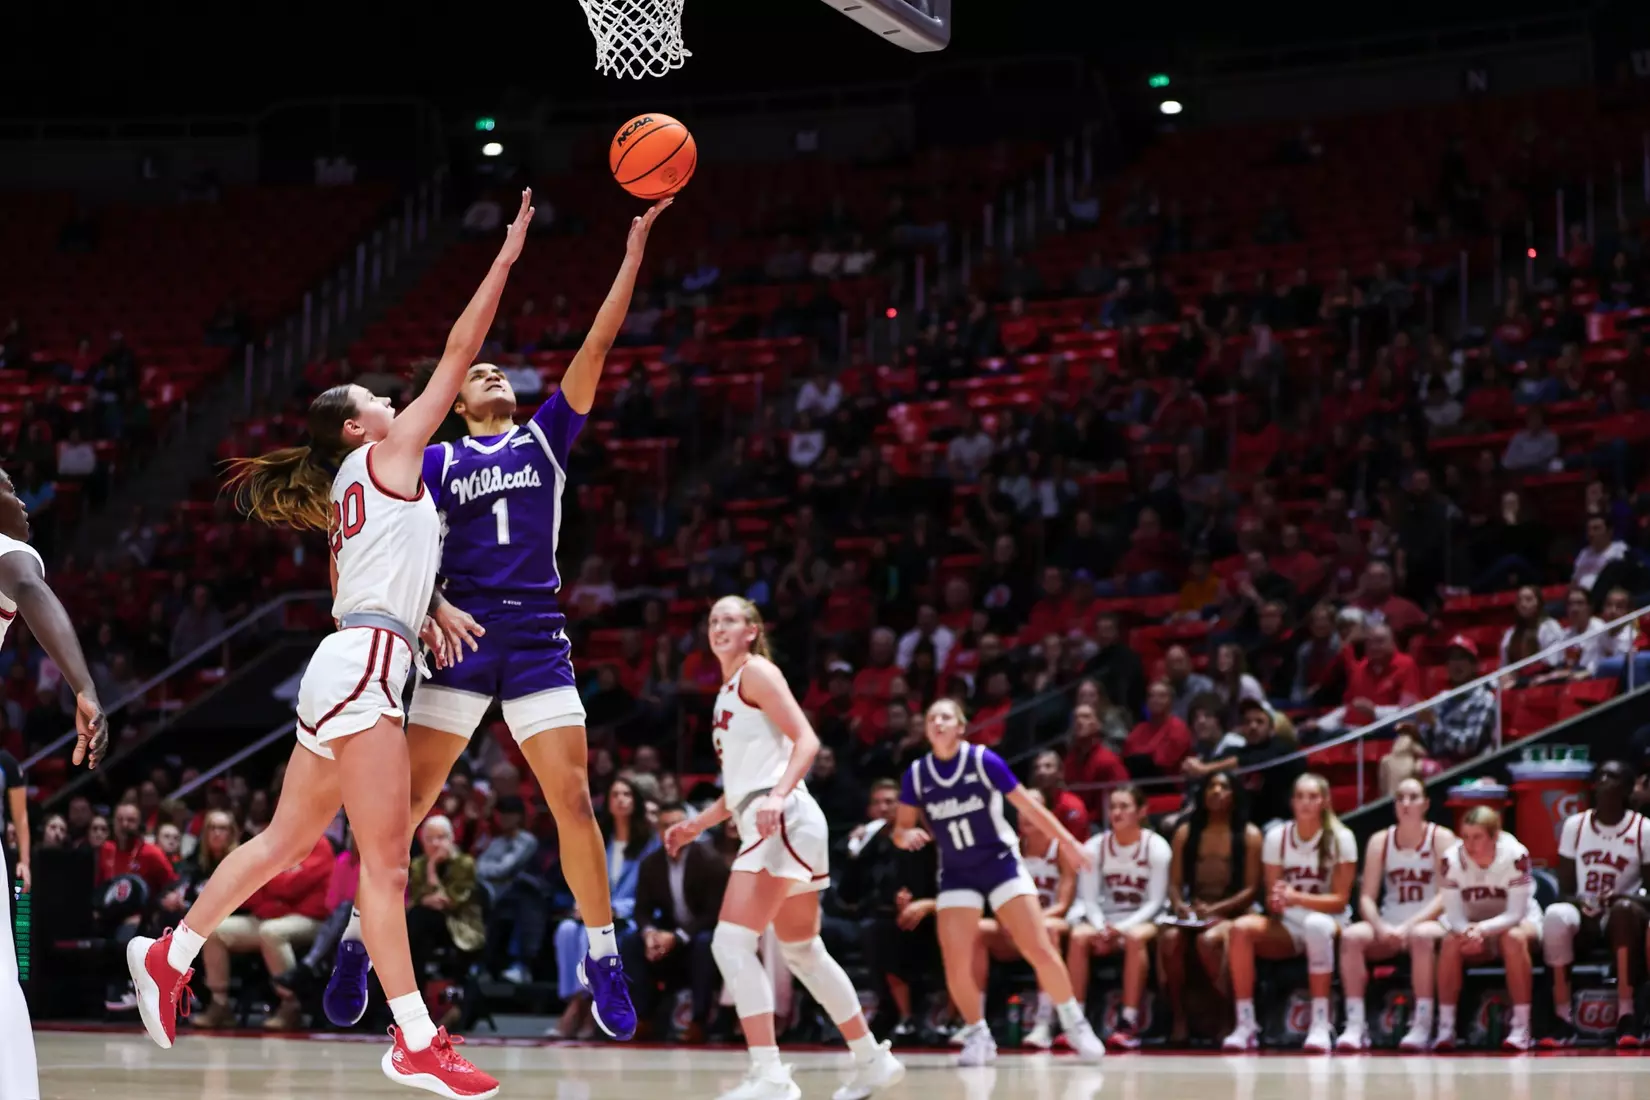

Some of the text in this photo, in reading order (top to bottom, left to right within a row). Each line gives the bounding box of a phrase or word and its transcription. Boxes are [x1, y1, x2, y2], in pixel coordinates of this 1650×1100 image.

[617, 116, 654, 147] NCAA
[450, 462, 542, 505] Wildcats
[491, 497, 510, 545] 1
[947, 817, 976, 851] 11
[1581, 850, 1629, 871] UTAH
[1388, 867, 1433, 885] UTAH
[1399, 885, 1423, 903] 10
[1461, 885, 1508, 901] UTAH
